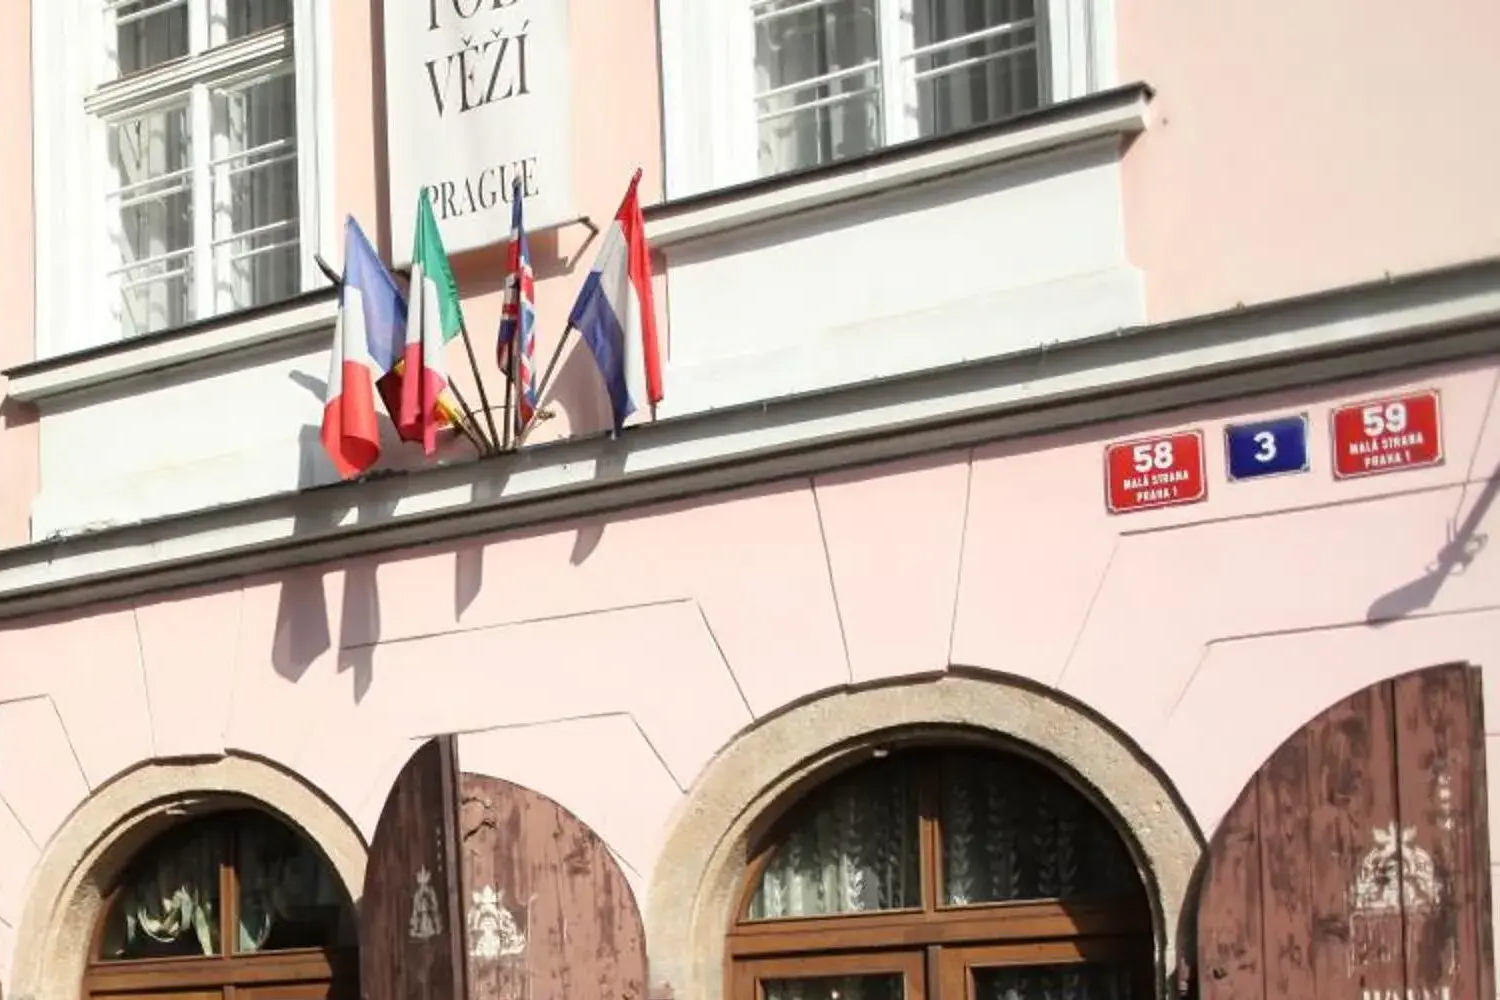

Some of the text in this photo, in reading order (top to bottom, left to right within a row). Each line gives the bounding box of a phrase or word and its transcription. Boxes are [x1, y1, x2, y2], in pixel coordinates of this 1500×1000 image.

[424, 19, 530, 117] VĚŽÍ
[1363, 403, 1406, 437] 59
[1133, 441, 1173, 473] 58
[1254, 431, 1277, 461] 3
